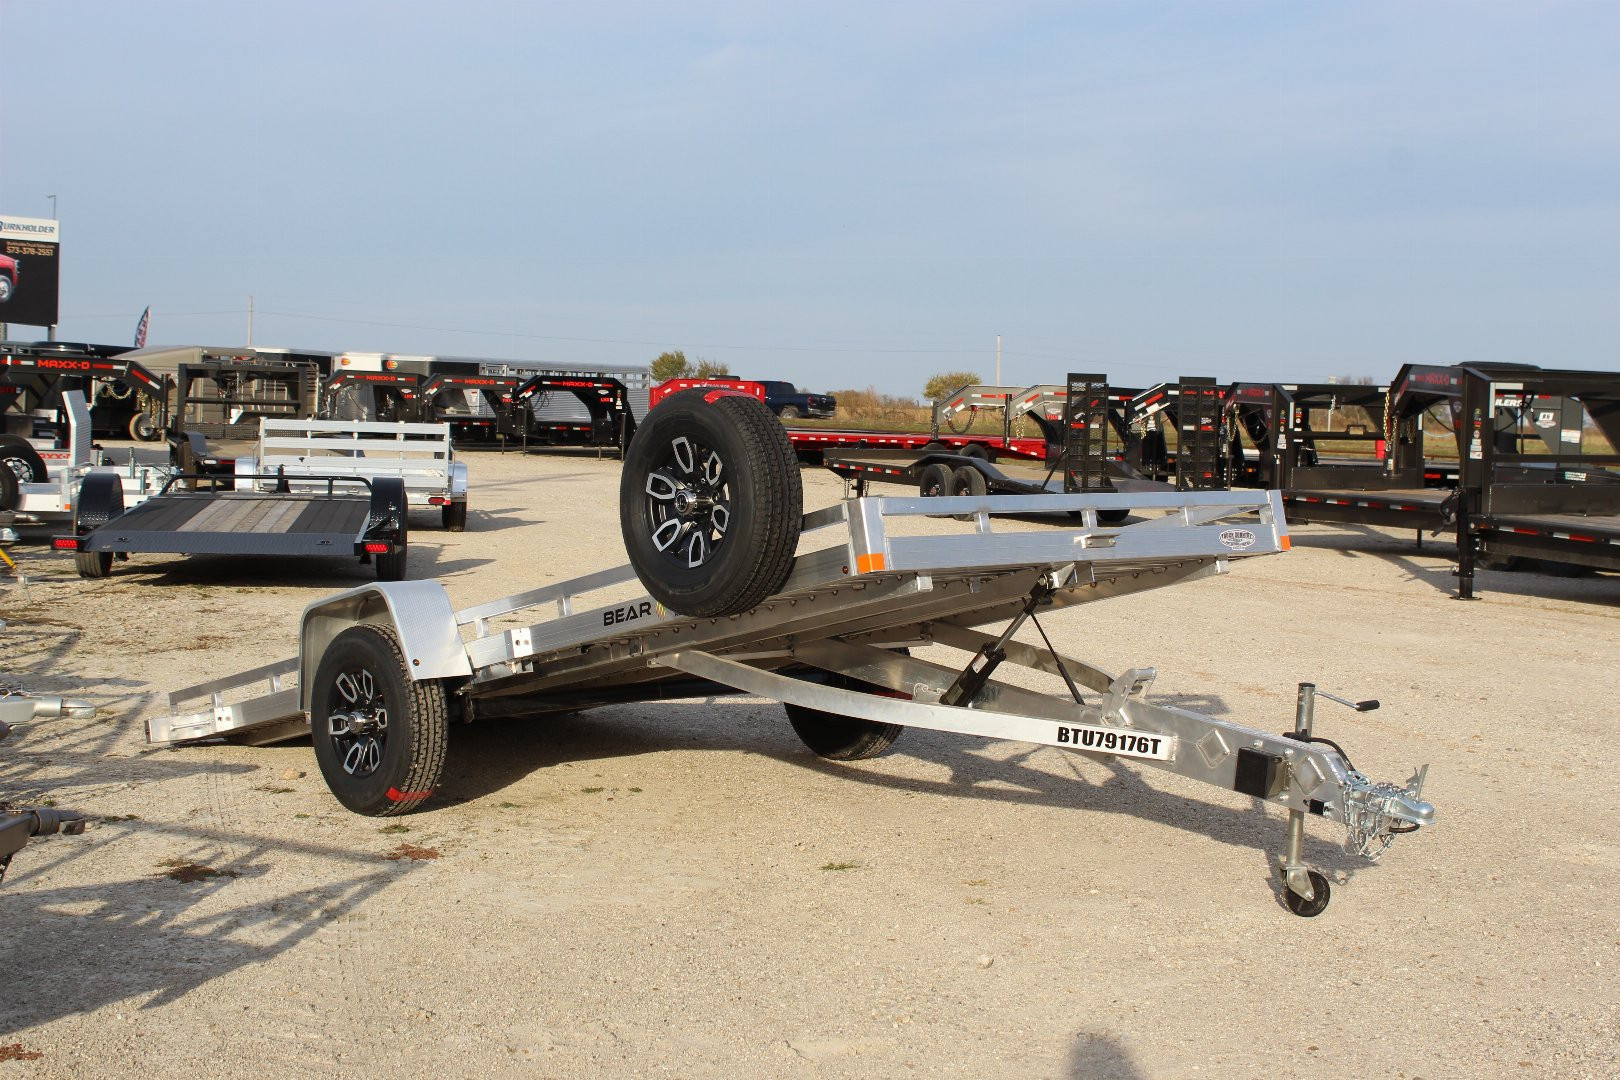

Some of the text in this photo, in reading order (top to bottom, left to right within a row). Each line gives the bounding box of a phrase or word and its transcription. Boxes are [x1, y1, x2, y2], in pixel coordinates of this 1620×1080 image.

[38, 359, 90, 370] MAXX-D
[603, 601, 652, 627] BEAR
[1057, 726, 1162, 755] BTU79176T
